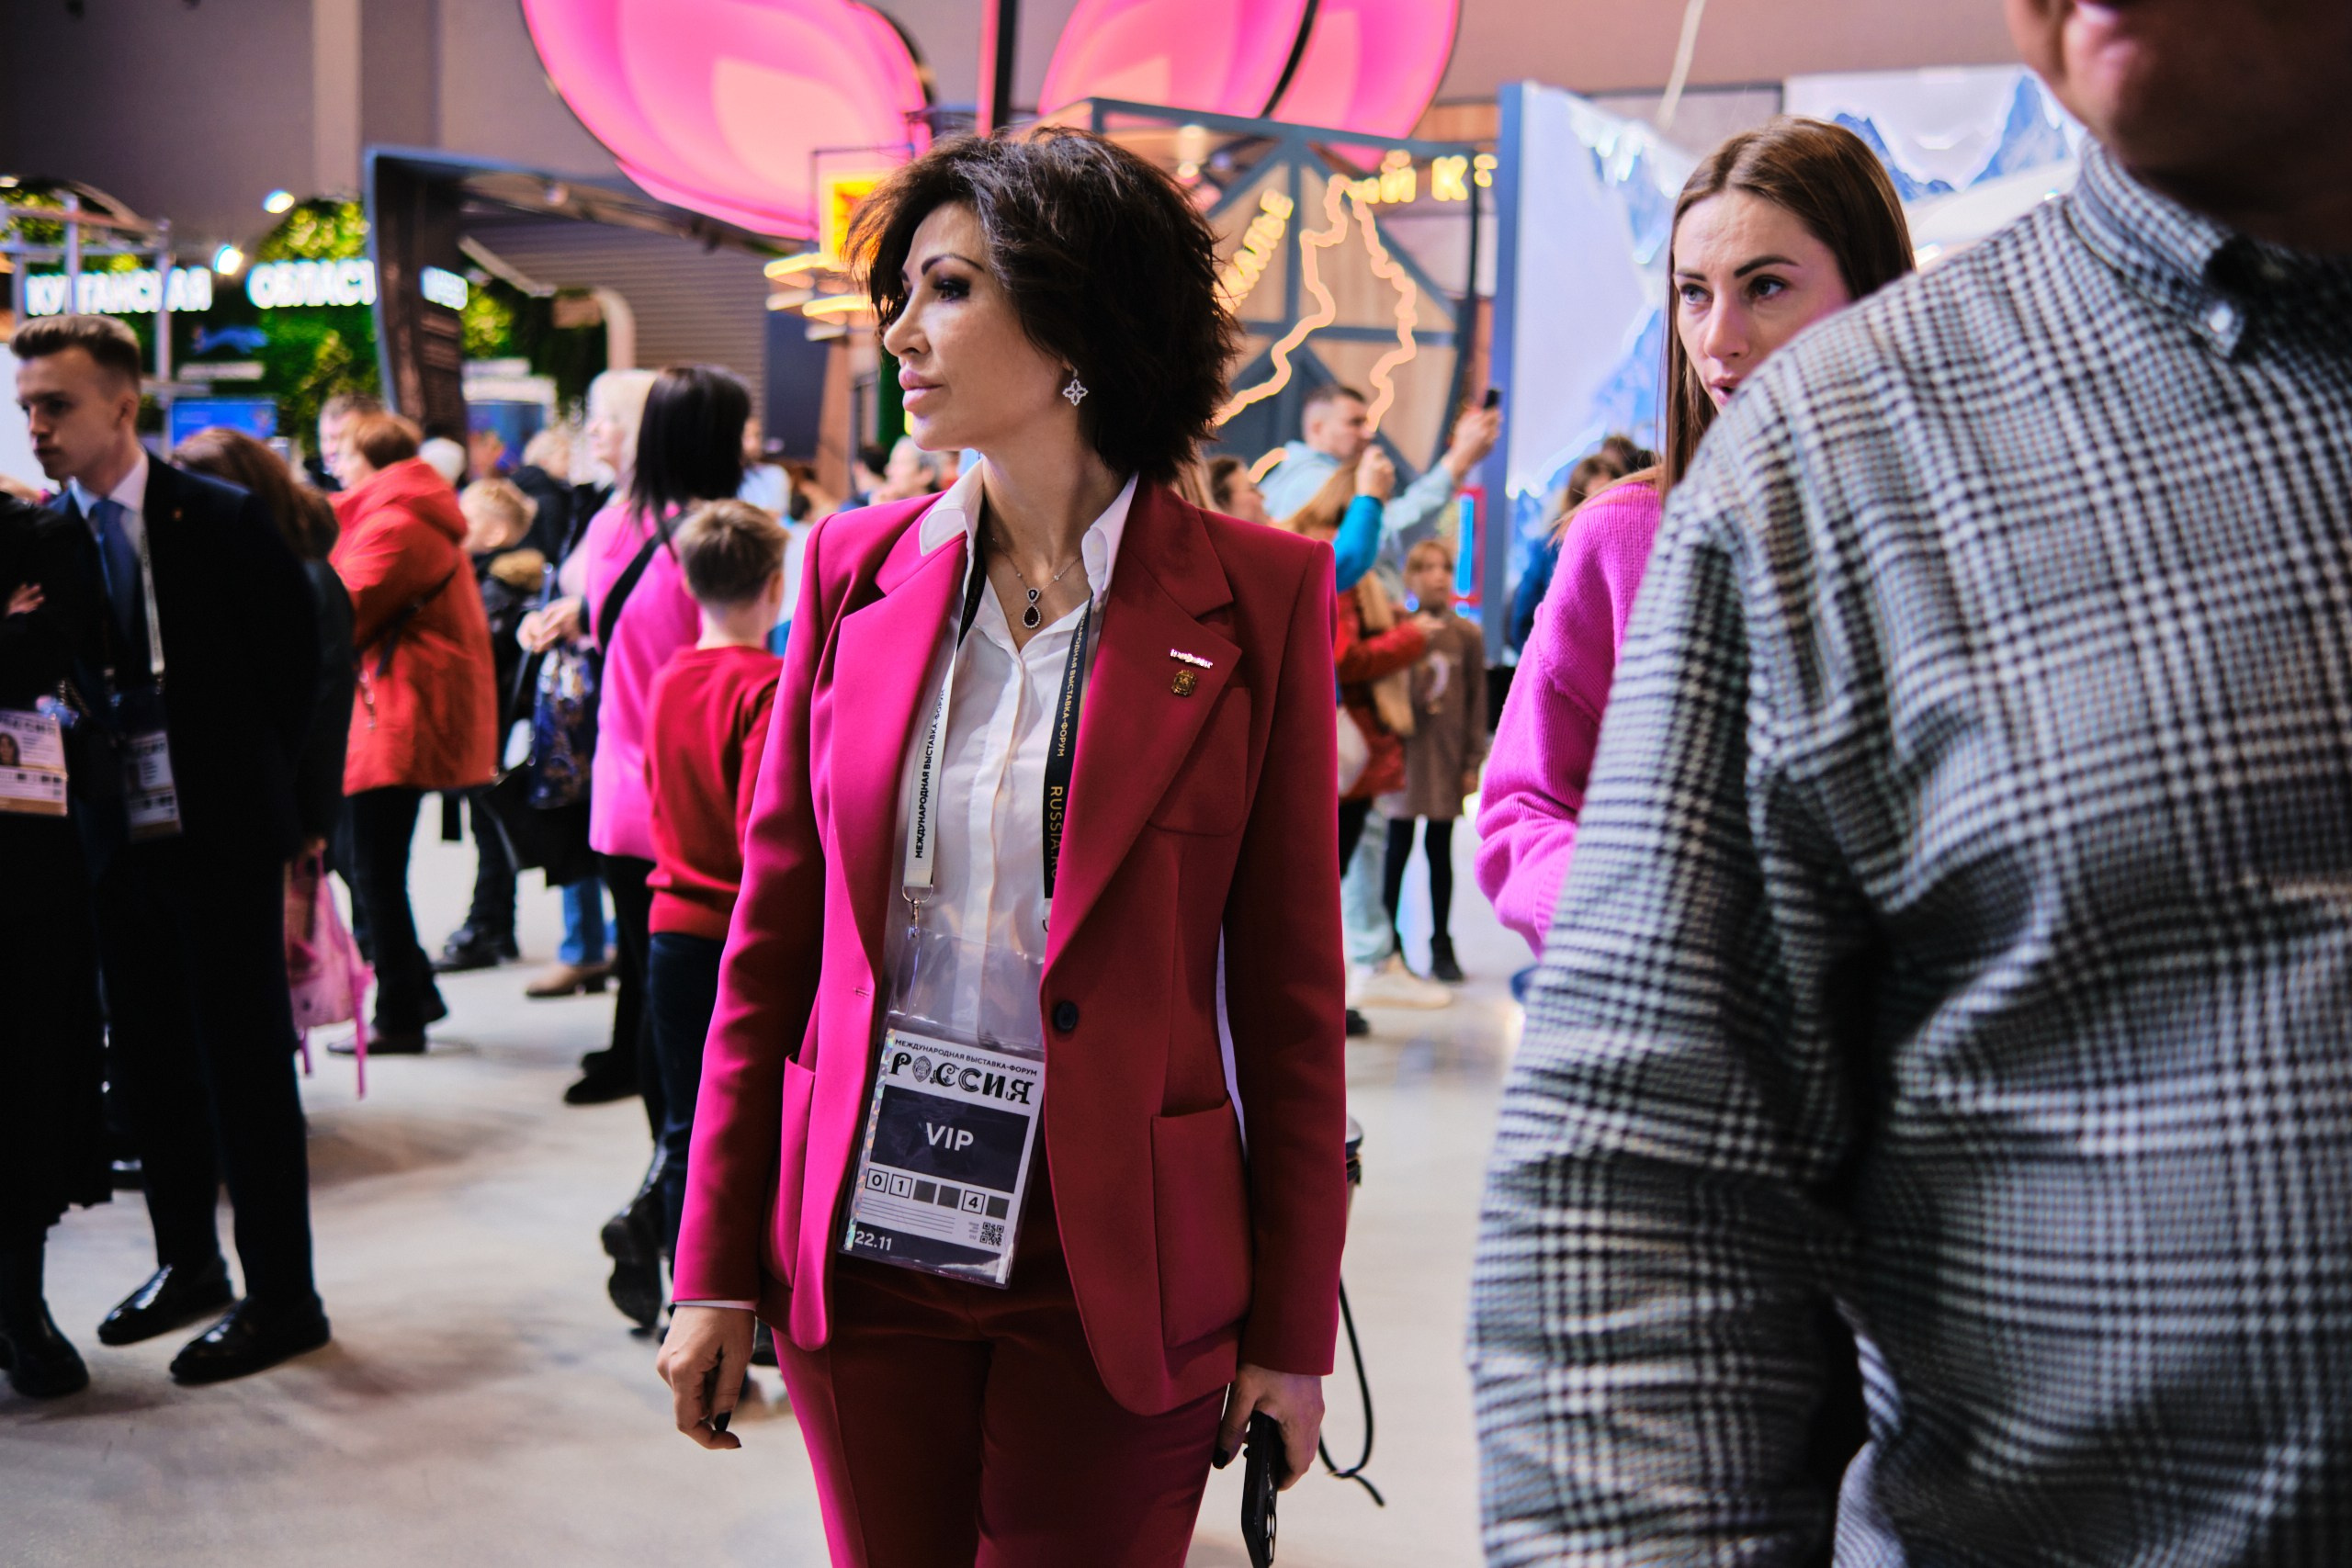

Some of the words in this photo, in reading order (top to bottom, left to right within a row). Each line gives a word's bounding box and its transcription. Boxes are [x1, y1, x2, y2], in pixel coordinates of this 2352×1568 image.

[246, 256, 377, 309] ОБЛАСТ
[1057, 670, 1077, 757] ВЫСТАВКА-ФОРУМ
[915, 772, 931, 859] МЕЖДУНАРОДНАЯ
[888, 1052, 1035, 1105] РОССИЯ
[895, 1039, 965, 1060] МЕЖДУНАРОДНАЯ
[966, 1055, 1037, 1077] ВЫСТАВКА-ФОРУМ
[926, 1122, 974, 1151] VIP
[898, 1180, 904, 1192] 1
[968, 1197, 978, 1209] 4
[854, 1231, 891, 1250] 22.11
